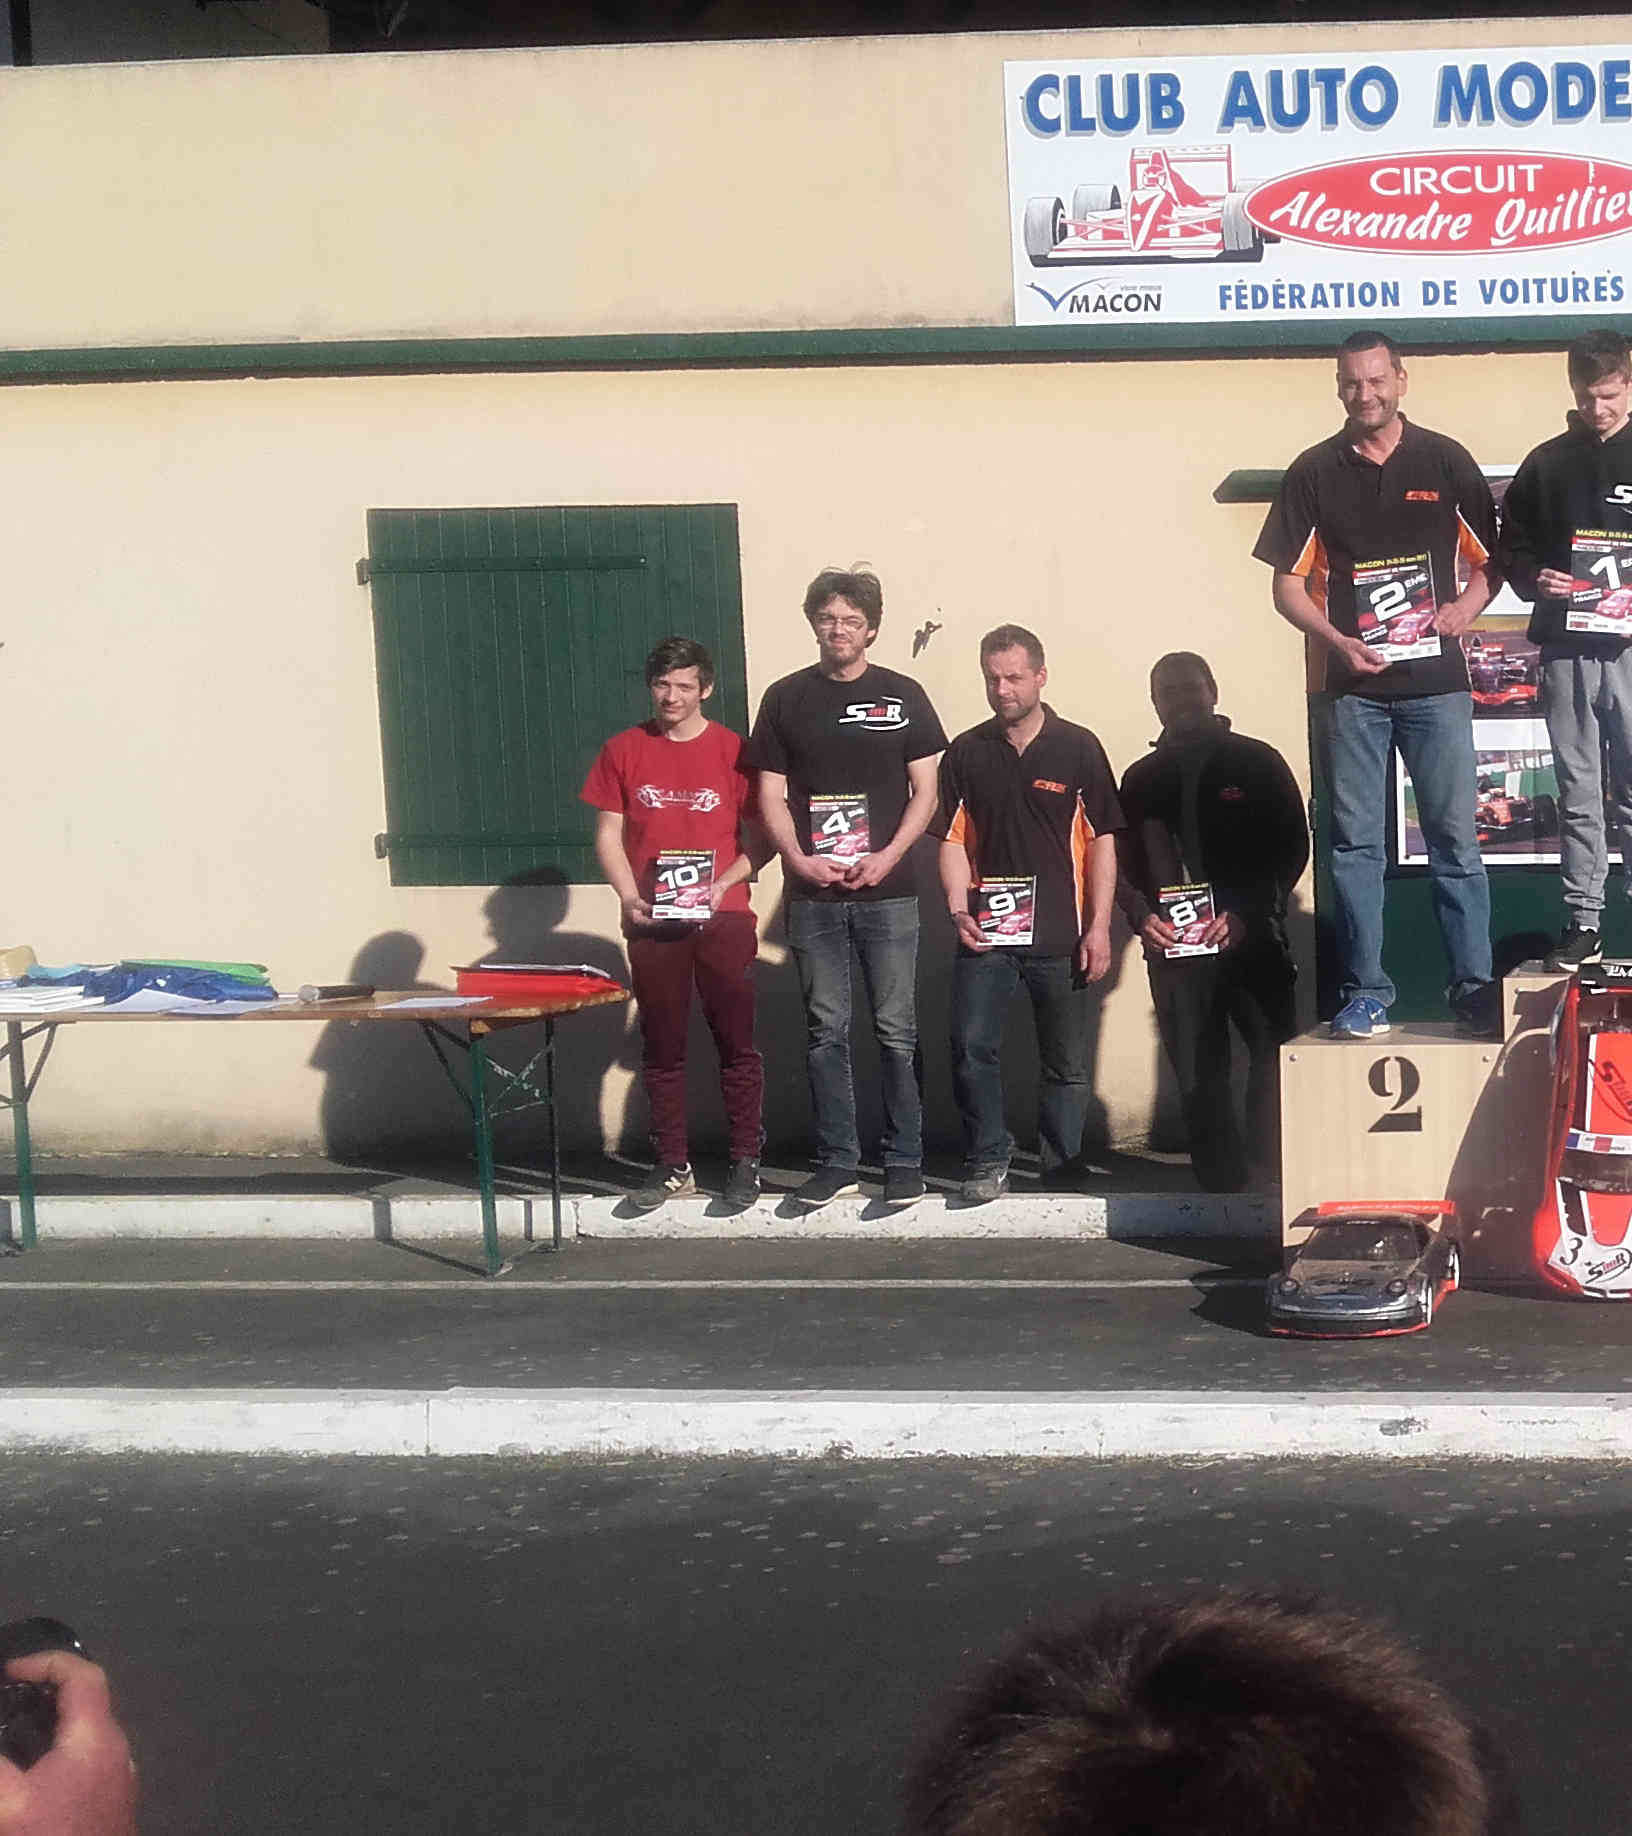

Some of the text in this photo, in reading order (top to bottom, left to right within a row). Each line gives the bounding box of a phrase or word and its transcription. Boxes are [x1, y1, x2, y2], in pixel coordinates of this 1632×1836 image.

[1021, 72, 1186, 139] CLUB
[1216, 64, 1400, 136] AUTO
[1369, 163, 1544, 197] CIRCUIT
[1269, 190, 1473, 242] Alexandre
[1068, 293, 1162, 314] MACON
[1218, 278, 1401, 311] FÉDÉRATION
[1421, 280, 1458, 307] DE
[1478, 274, 1625, 306] VOITURES
[1589, 555, 1621, 591] 1
[1368, 581, 1413, 623] 2
[822, 810, 851, 835] 4
[658, 864, 699, 890] 10
[988, 891, 1016, 917] 9
[1169, 900, 1198, 928] 8
[1367, 1055, 1423, 1133] 2
[1559, 1237, 1583, 1266] 3
